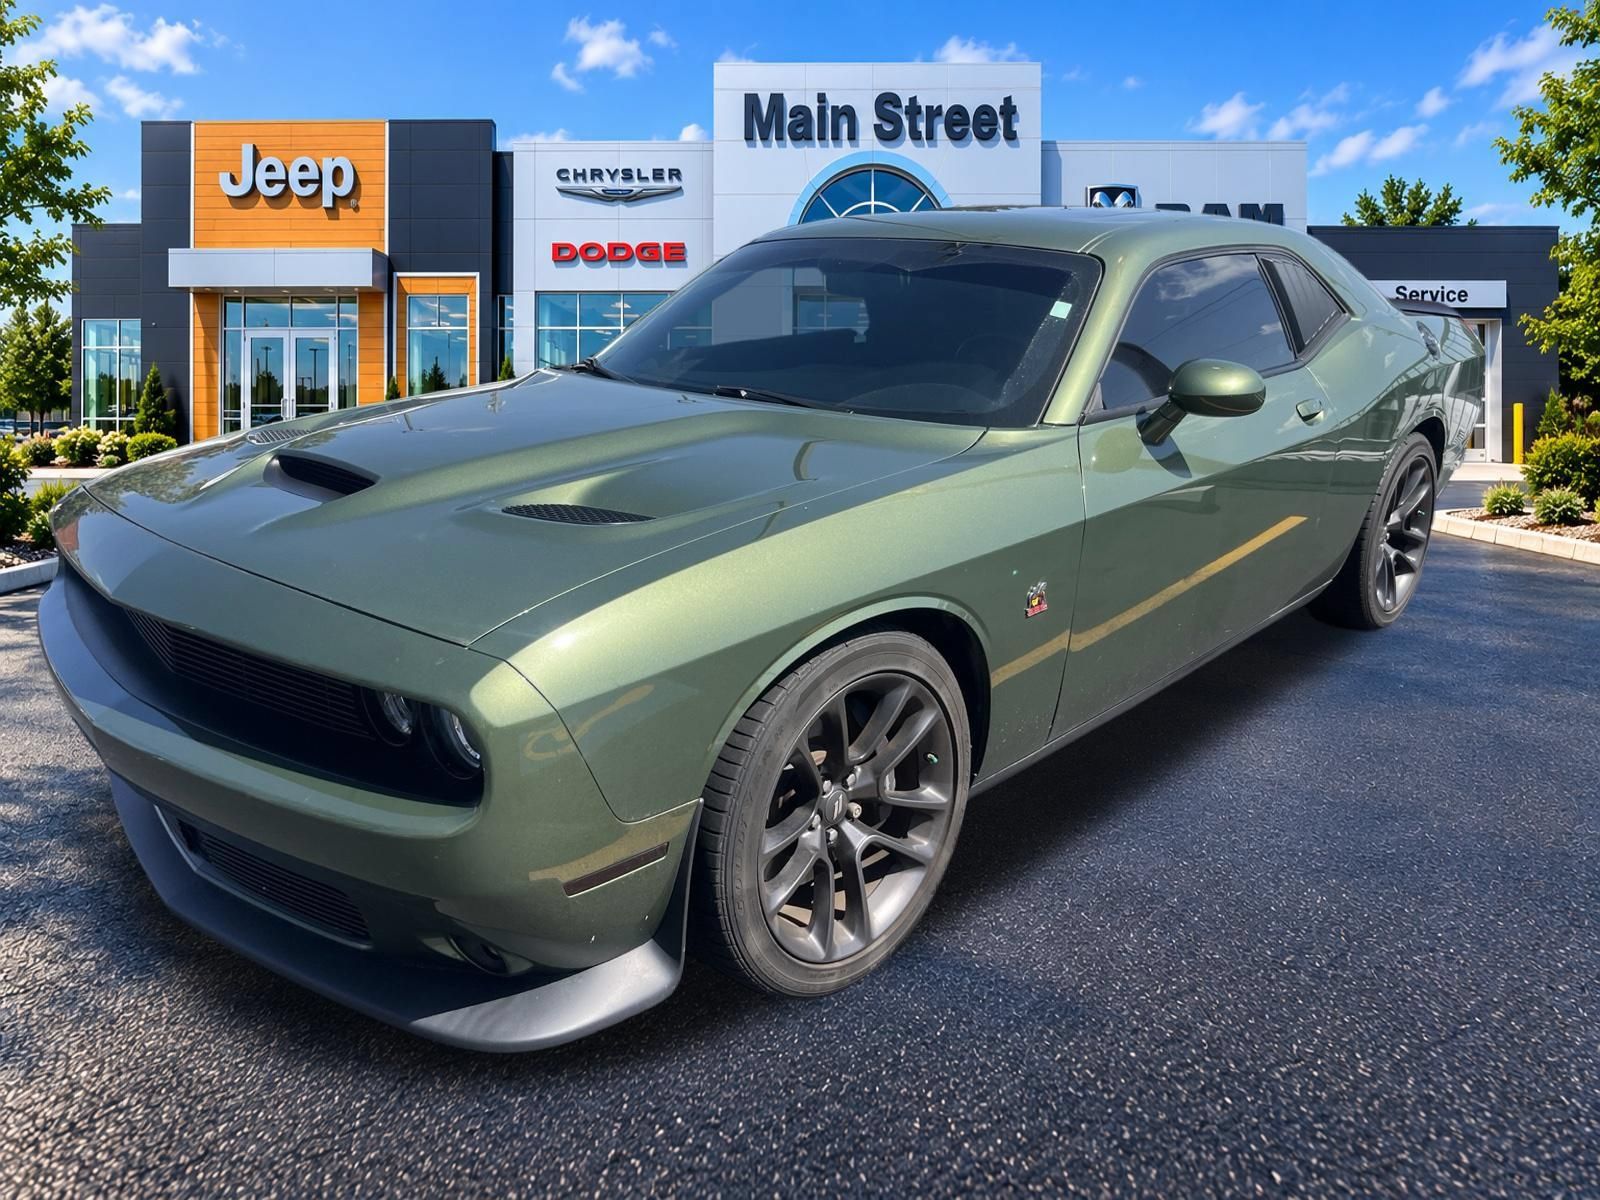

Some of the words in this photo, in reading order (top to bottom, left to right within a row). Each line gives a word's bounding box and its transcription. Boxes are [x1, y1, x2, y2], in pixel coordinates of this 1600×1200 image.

[744, 93, 857, 141] Main
[873, 92, 1017, 141] Street
[219, 143, 355, 209] Jeep
[556, 168, 682, 182] CHRYSLER
[552, 242, 686, 261] DODGE
[1395, 285, 1468, 303] Service
